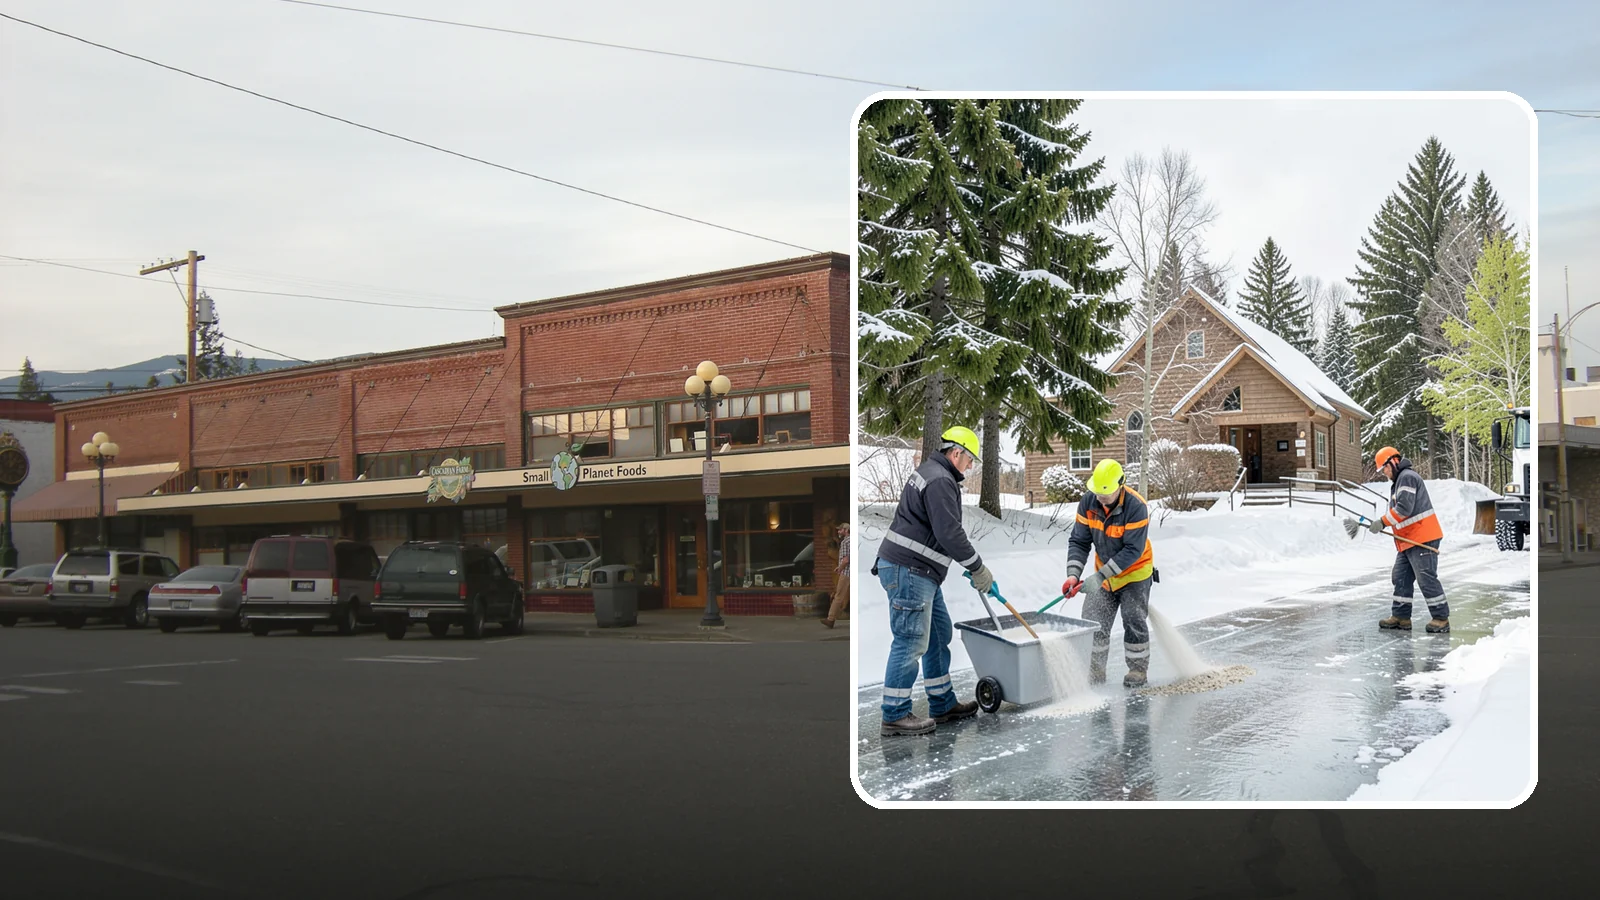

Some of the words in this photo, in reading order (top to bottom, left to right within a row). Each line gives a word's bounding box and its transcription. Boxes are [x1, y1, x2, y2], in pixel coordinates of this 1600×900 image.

[523, 471, 549, 483] Small
[583, 468, 614, 479] Planet
[617, 464, 647, 477] Foods
